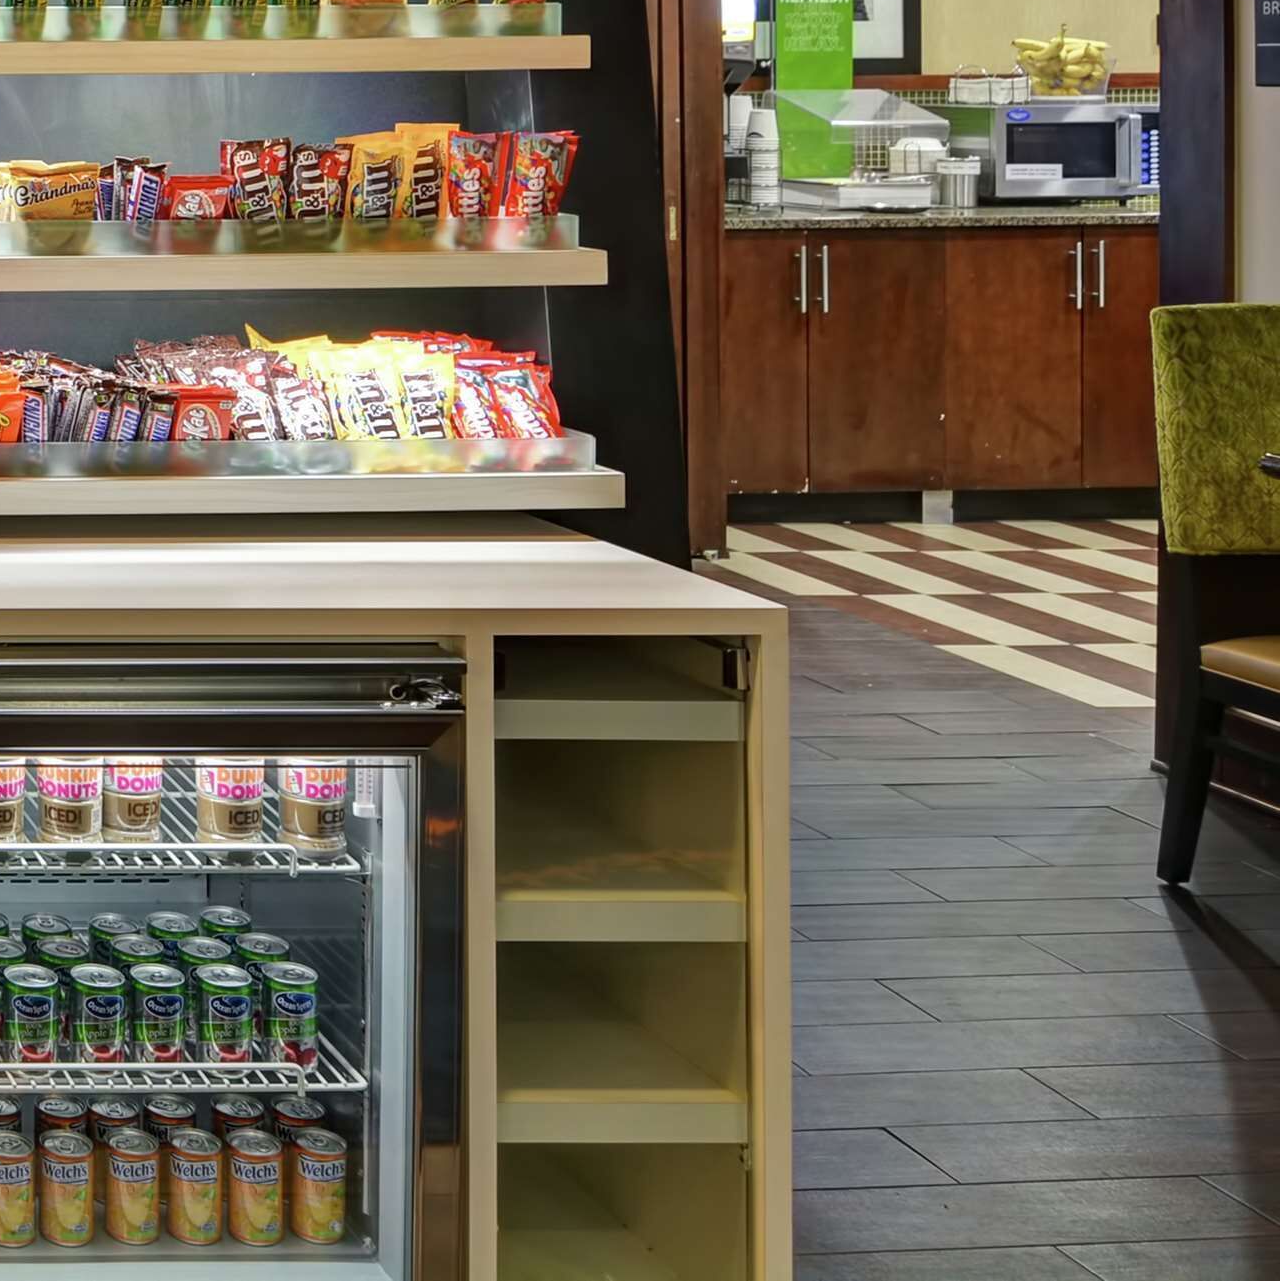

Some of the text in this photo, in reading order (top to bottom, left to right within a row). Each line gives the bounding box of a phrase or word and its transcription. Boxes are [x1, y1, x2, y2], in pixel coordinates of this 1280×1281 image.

[363, 159, 394, 220] m&m
[412, 142, 441, 220] m&m
[14, 178, 96, 208] Grandma's
[35, 776, 98, 799] DONUTS
[14, 999, 32, 1014] Ocean
[277, 996, 295, 1012] Ocean
[44, 1163, 88, 1180] Welch's
[111, 1161, 156, 1178] Welch's
[171, 1161, 216, 1178] Welch's
[234, 1163, 278, 1180] Welch's
[300, 1161, 345, 1179] Welch's
